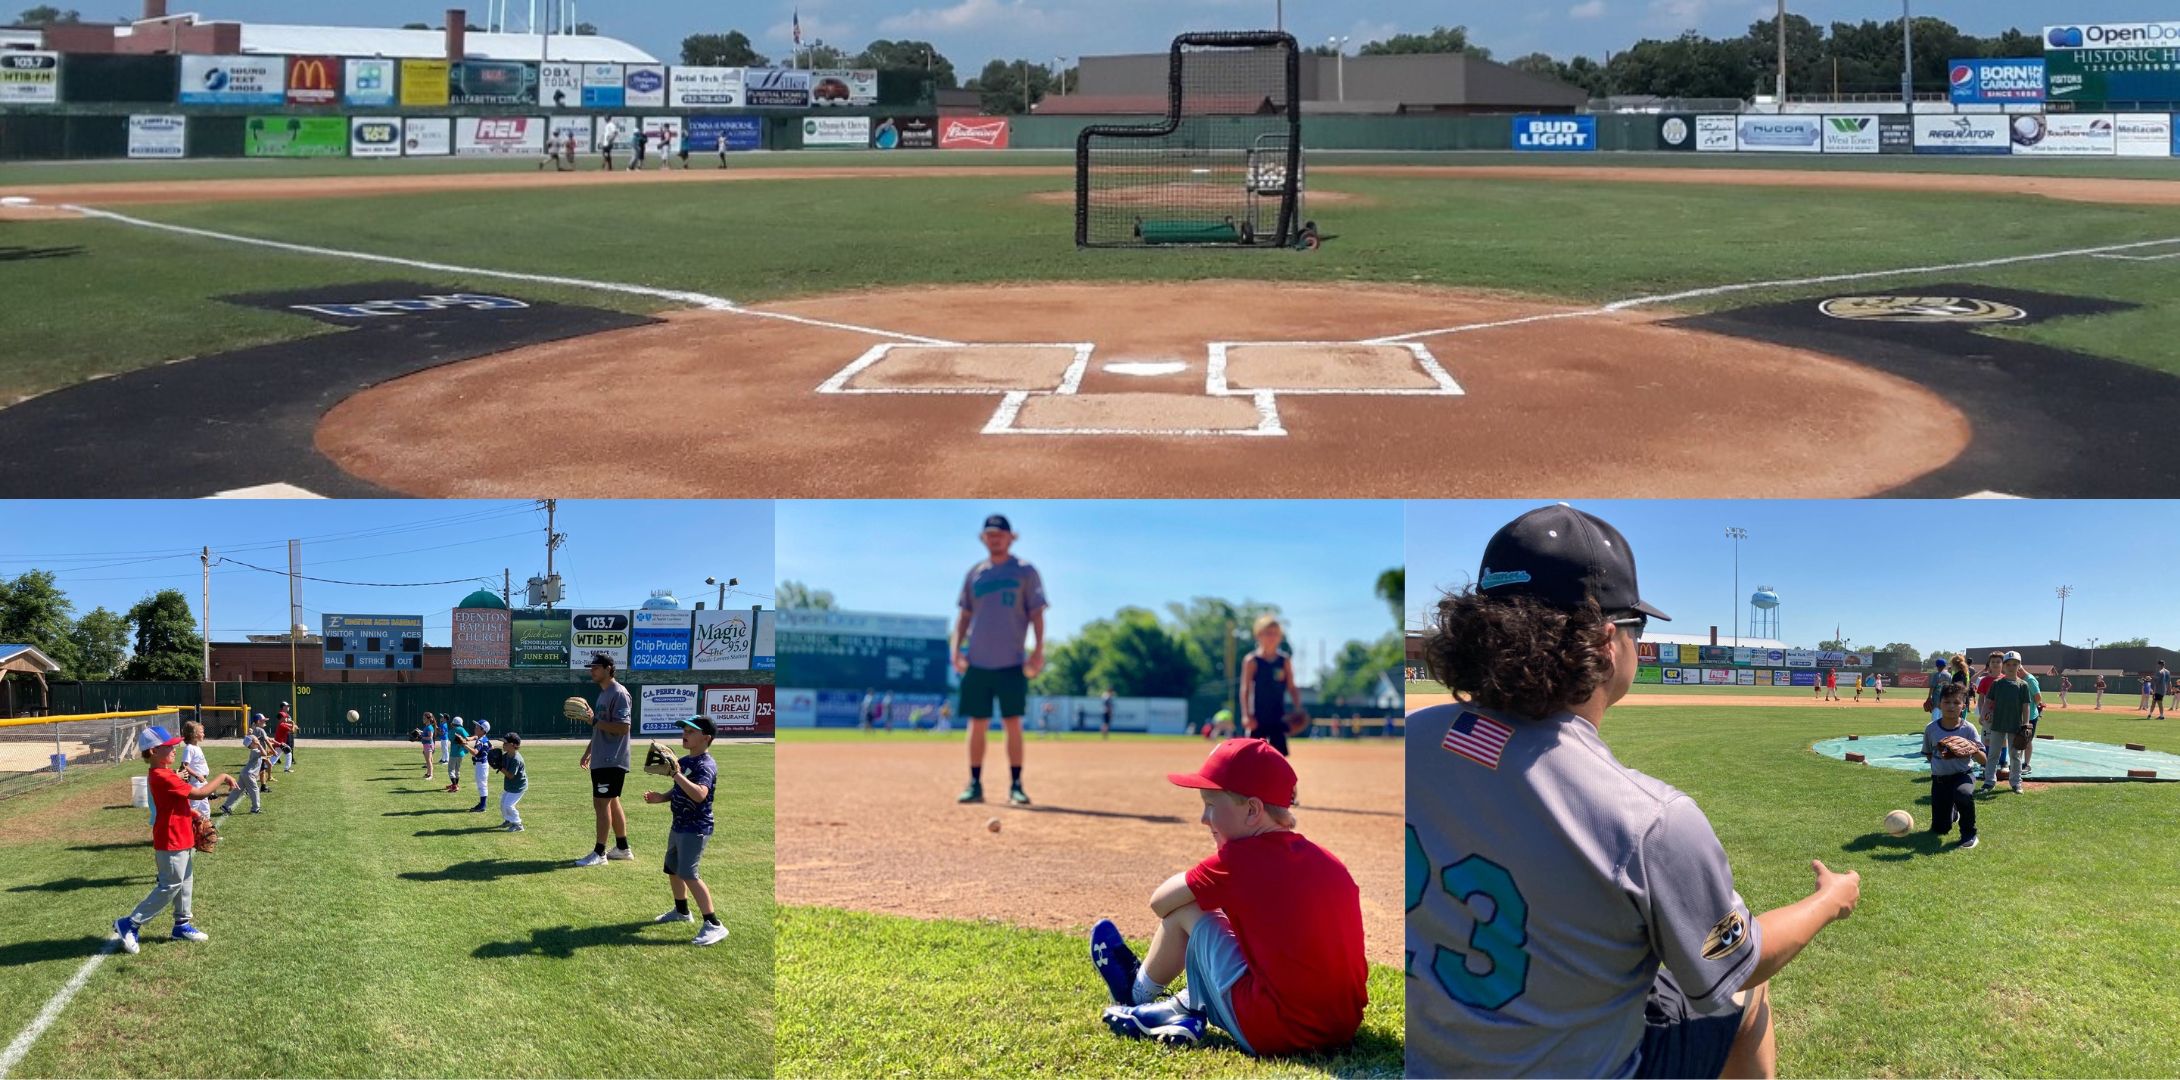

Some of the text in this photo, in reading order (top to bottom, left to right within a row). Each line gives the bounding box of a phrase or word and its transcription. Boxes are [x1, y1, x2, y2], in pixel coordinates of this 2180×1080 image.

[2086, 24, 2180, 44] OpenDo
[2073, 49, 2157, 63] HISTORIC
[13, 57, 43, 68] 103.7
[543, 67, 571, 77] OBX
[1980, 66, 2027, 79] BORN
[1980, 79, 2044, 89] CAROLINAS
[1529, 121, 1578, 133] BUD
[1753, 125, 1805, 133] NUCOR
[2117, 125, 2165, 133] Mediacom
[1928, 129, 1995, 139] REGULATOR
[1520, 133, 1588, 146] LIGHT
[455, 612, 508, 622] EDENTON
[459, 623, 503, 632] BAPTIST
[586, 616, 616, 629] 103.7
[457, 632, 505, 642] CHURCH
[696, 623, 747, 645] Magic
[352, 639, 358, 647] H
[576, 634, 623, 645] WTIB-FM
[634, 640, 688, 653] Chip Pruden
[727, 639, 749, 653] 95.9
[325, 657, 345, 665] BALL
[634, 654, 687, 667] (252)482-2673
[296, 686, 311, 695] 300
[656, 688, 676, 696] PERRY
[682, 689, 697, 698] SON
[722, 694, 751, 703] FARM
[711, 703, 751, 712] BUREAU
